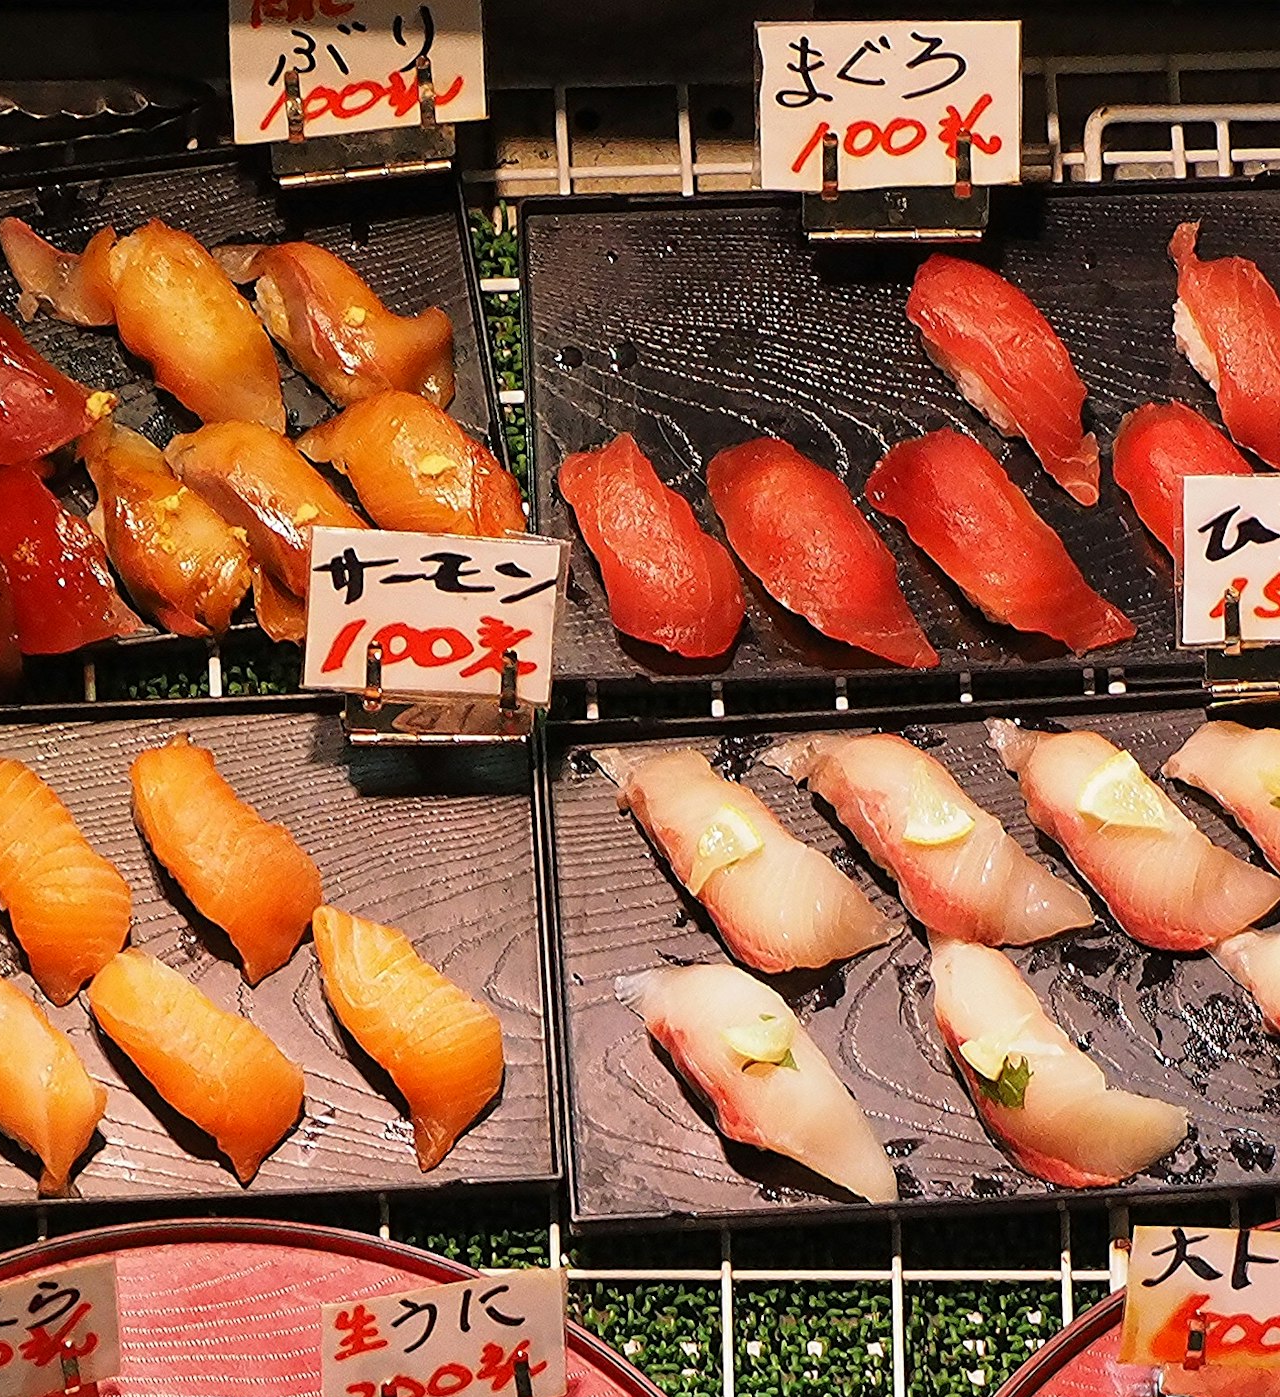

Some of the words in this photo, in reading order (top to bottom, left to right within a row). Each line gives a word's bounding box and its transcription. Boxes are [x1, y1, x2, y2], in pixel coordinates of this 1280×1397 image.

[267, 5, 435, 86] ぶり
[775, 32, 968, 107] まぐろ
[312, 547, 558, 604] サーモン
[334, 1284, 526, 1361] 生うに
